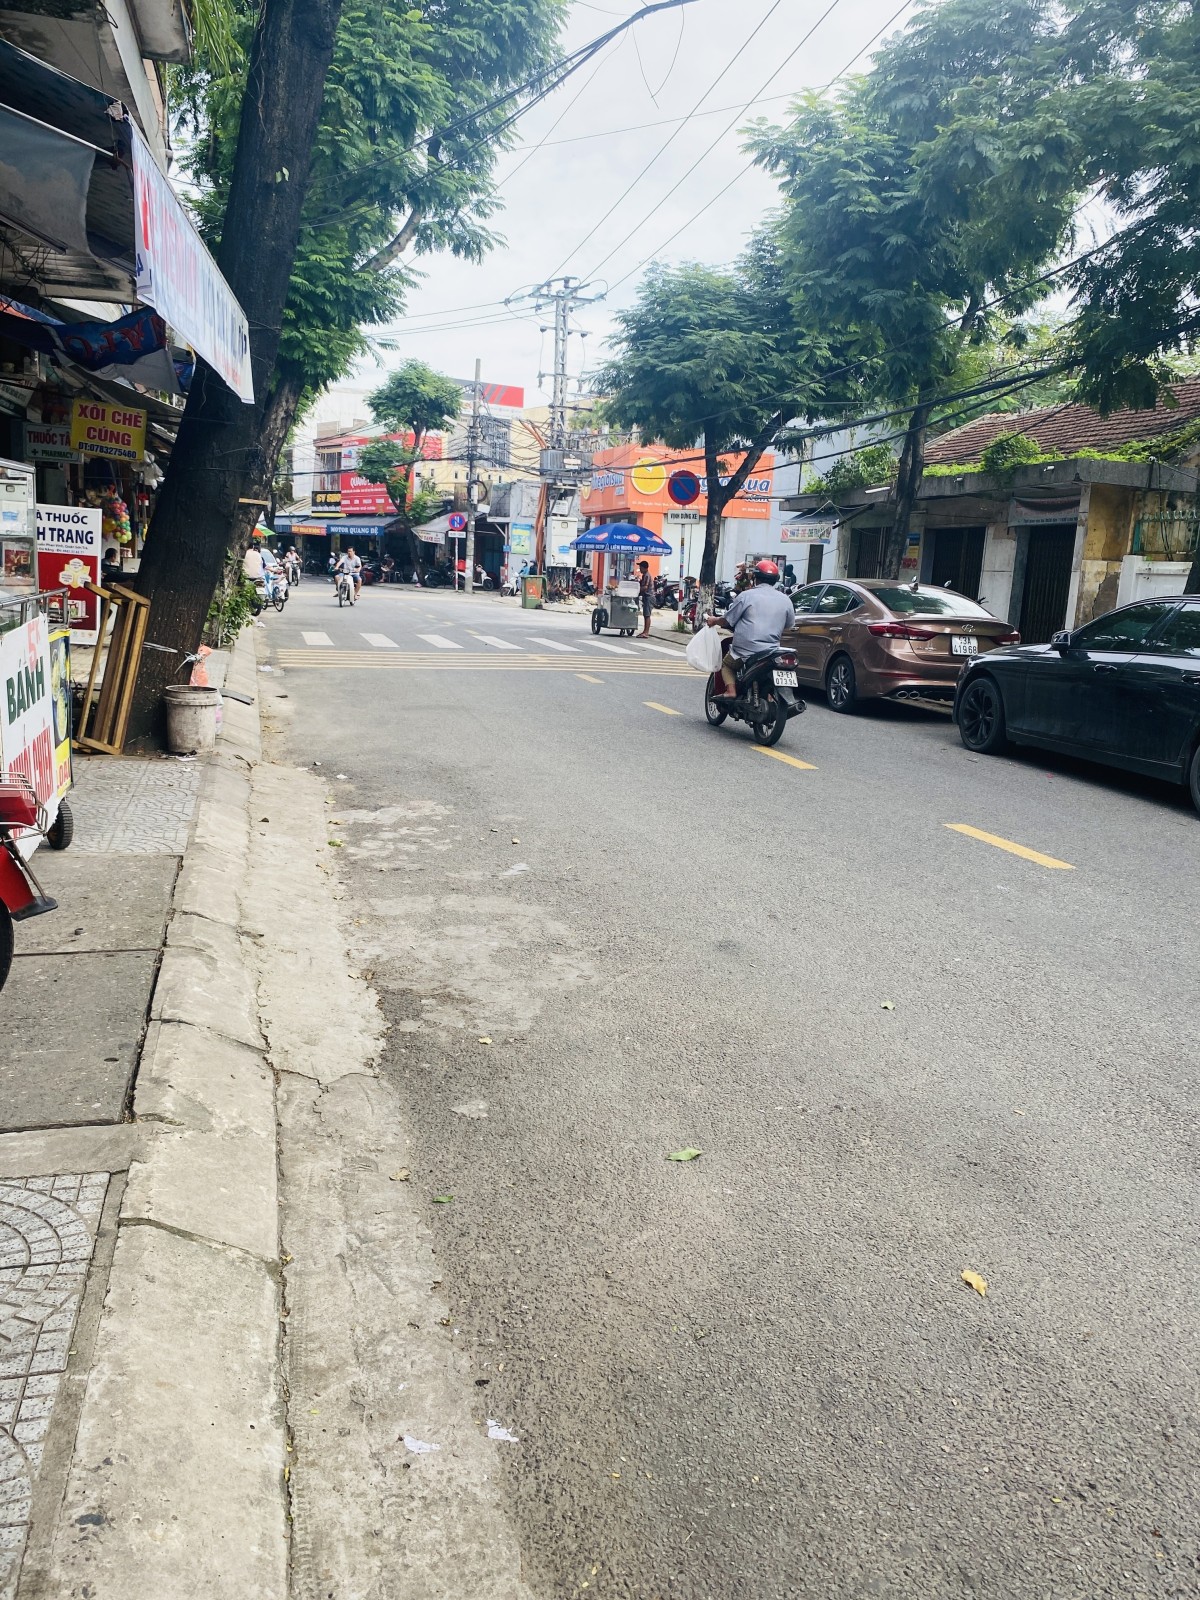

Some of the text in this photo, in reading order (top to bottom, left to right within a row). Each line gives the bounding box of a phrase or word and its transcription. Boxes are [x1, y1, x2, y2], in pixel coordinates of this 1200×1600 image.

[78, 404, 143, 428] XÔI CHÈ
[27, 427, 72, 447] THUỐC TÂ
[86, 425, 132, 447] CÚNG
[41, 449, 73, 459] PHARMACY
[45, 512, 88, 525] THUỐC
[48, 527, 94, 545] TRANG
[953, 645, 977, 654] 41968
[6, 656, 46, 726] BÁNH
